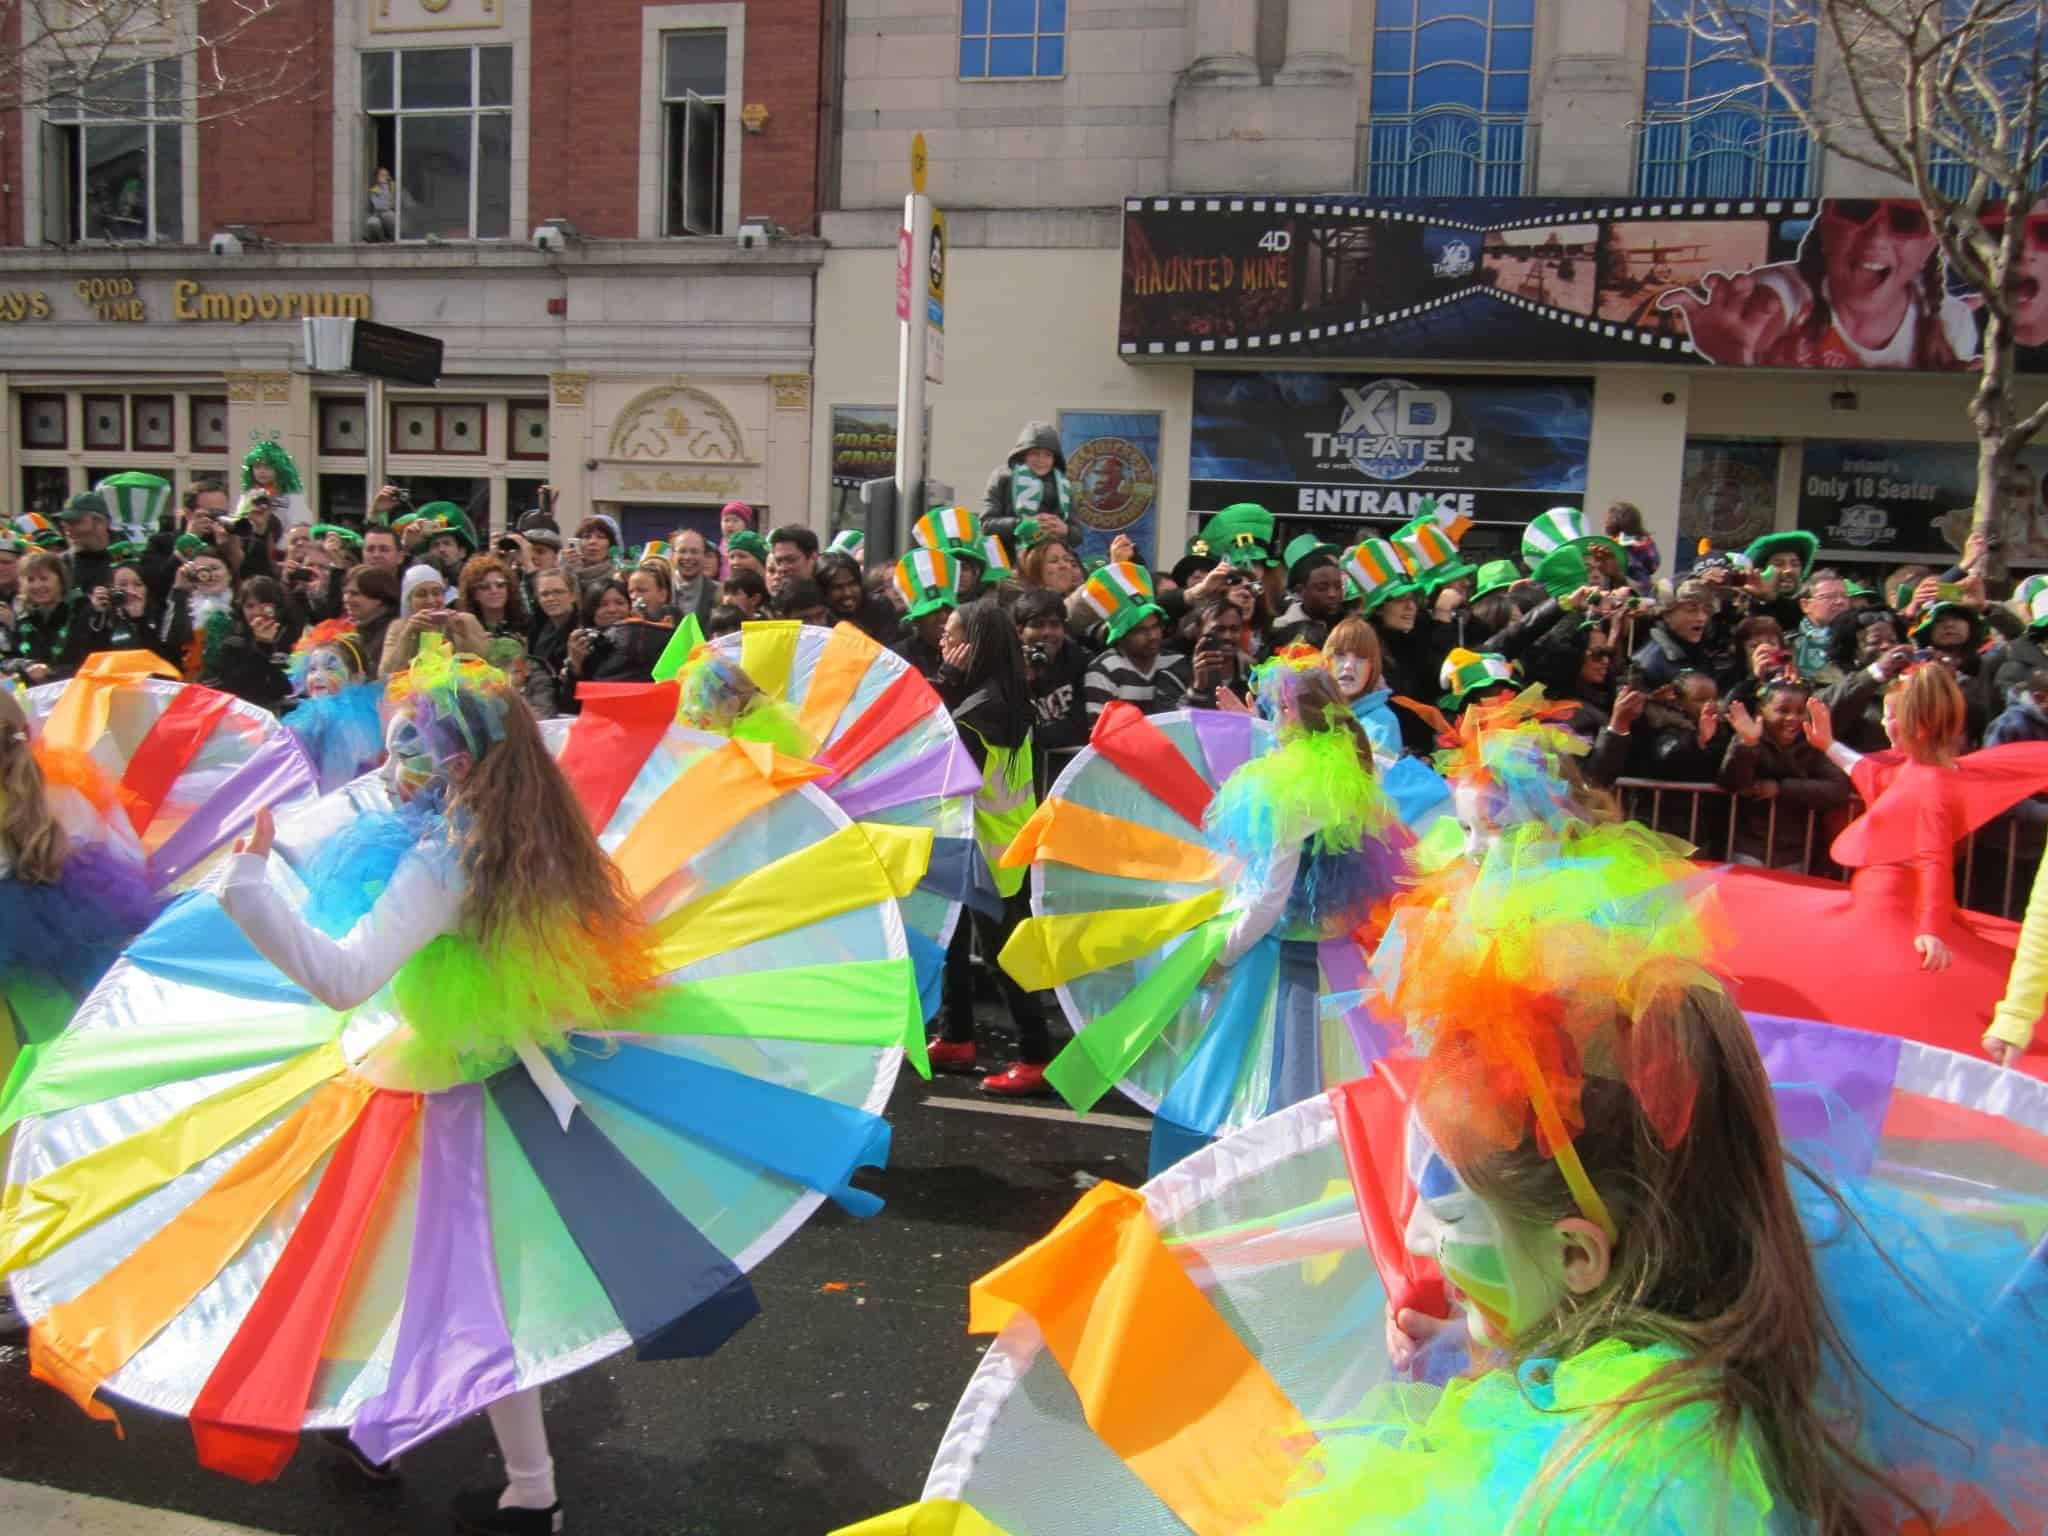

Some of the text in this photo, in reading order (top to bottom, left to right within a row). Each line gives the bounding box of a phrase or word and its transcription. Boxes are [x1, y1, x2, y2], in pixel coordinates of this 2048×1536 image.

[1258, 230, 1290, 252] 4D
[1134, 252, 1290, 295] HAUNTED MINE
[75, 277, 135, 301] GOOD
[173, 279, 372, 323] Emporium
[95, 299, 144, 321] TIME
[1339, 387, 1453, 437] XD
[1304, 431, 1475, 463] THEATER
[1808, 475, 1937, 502] Only 18 Seater
